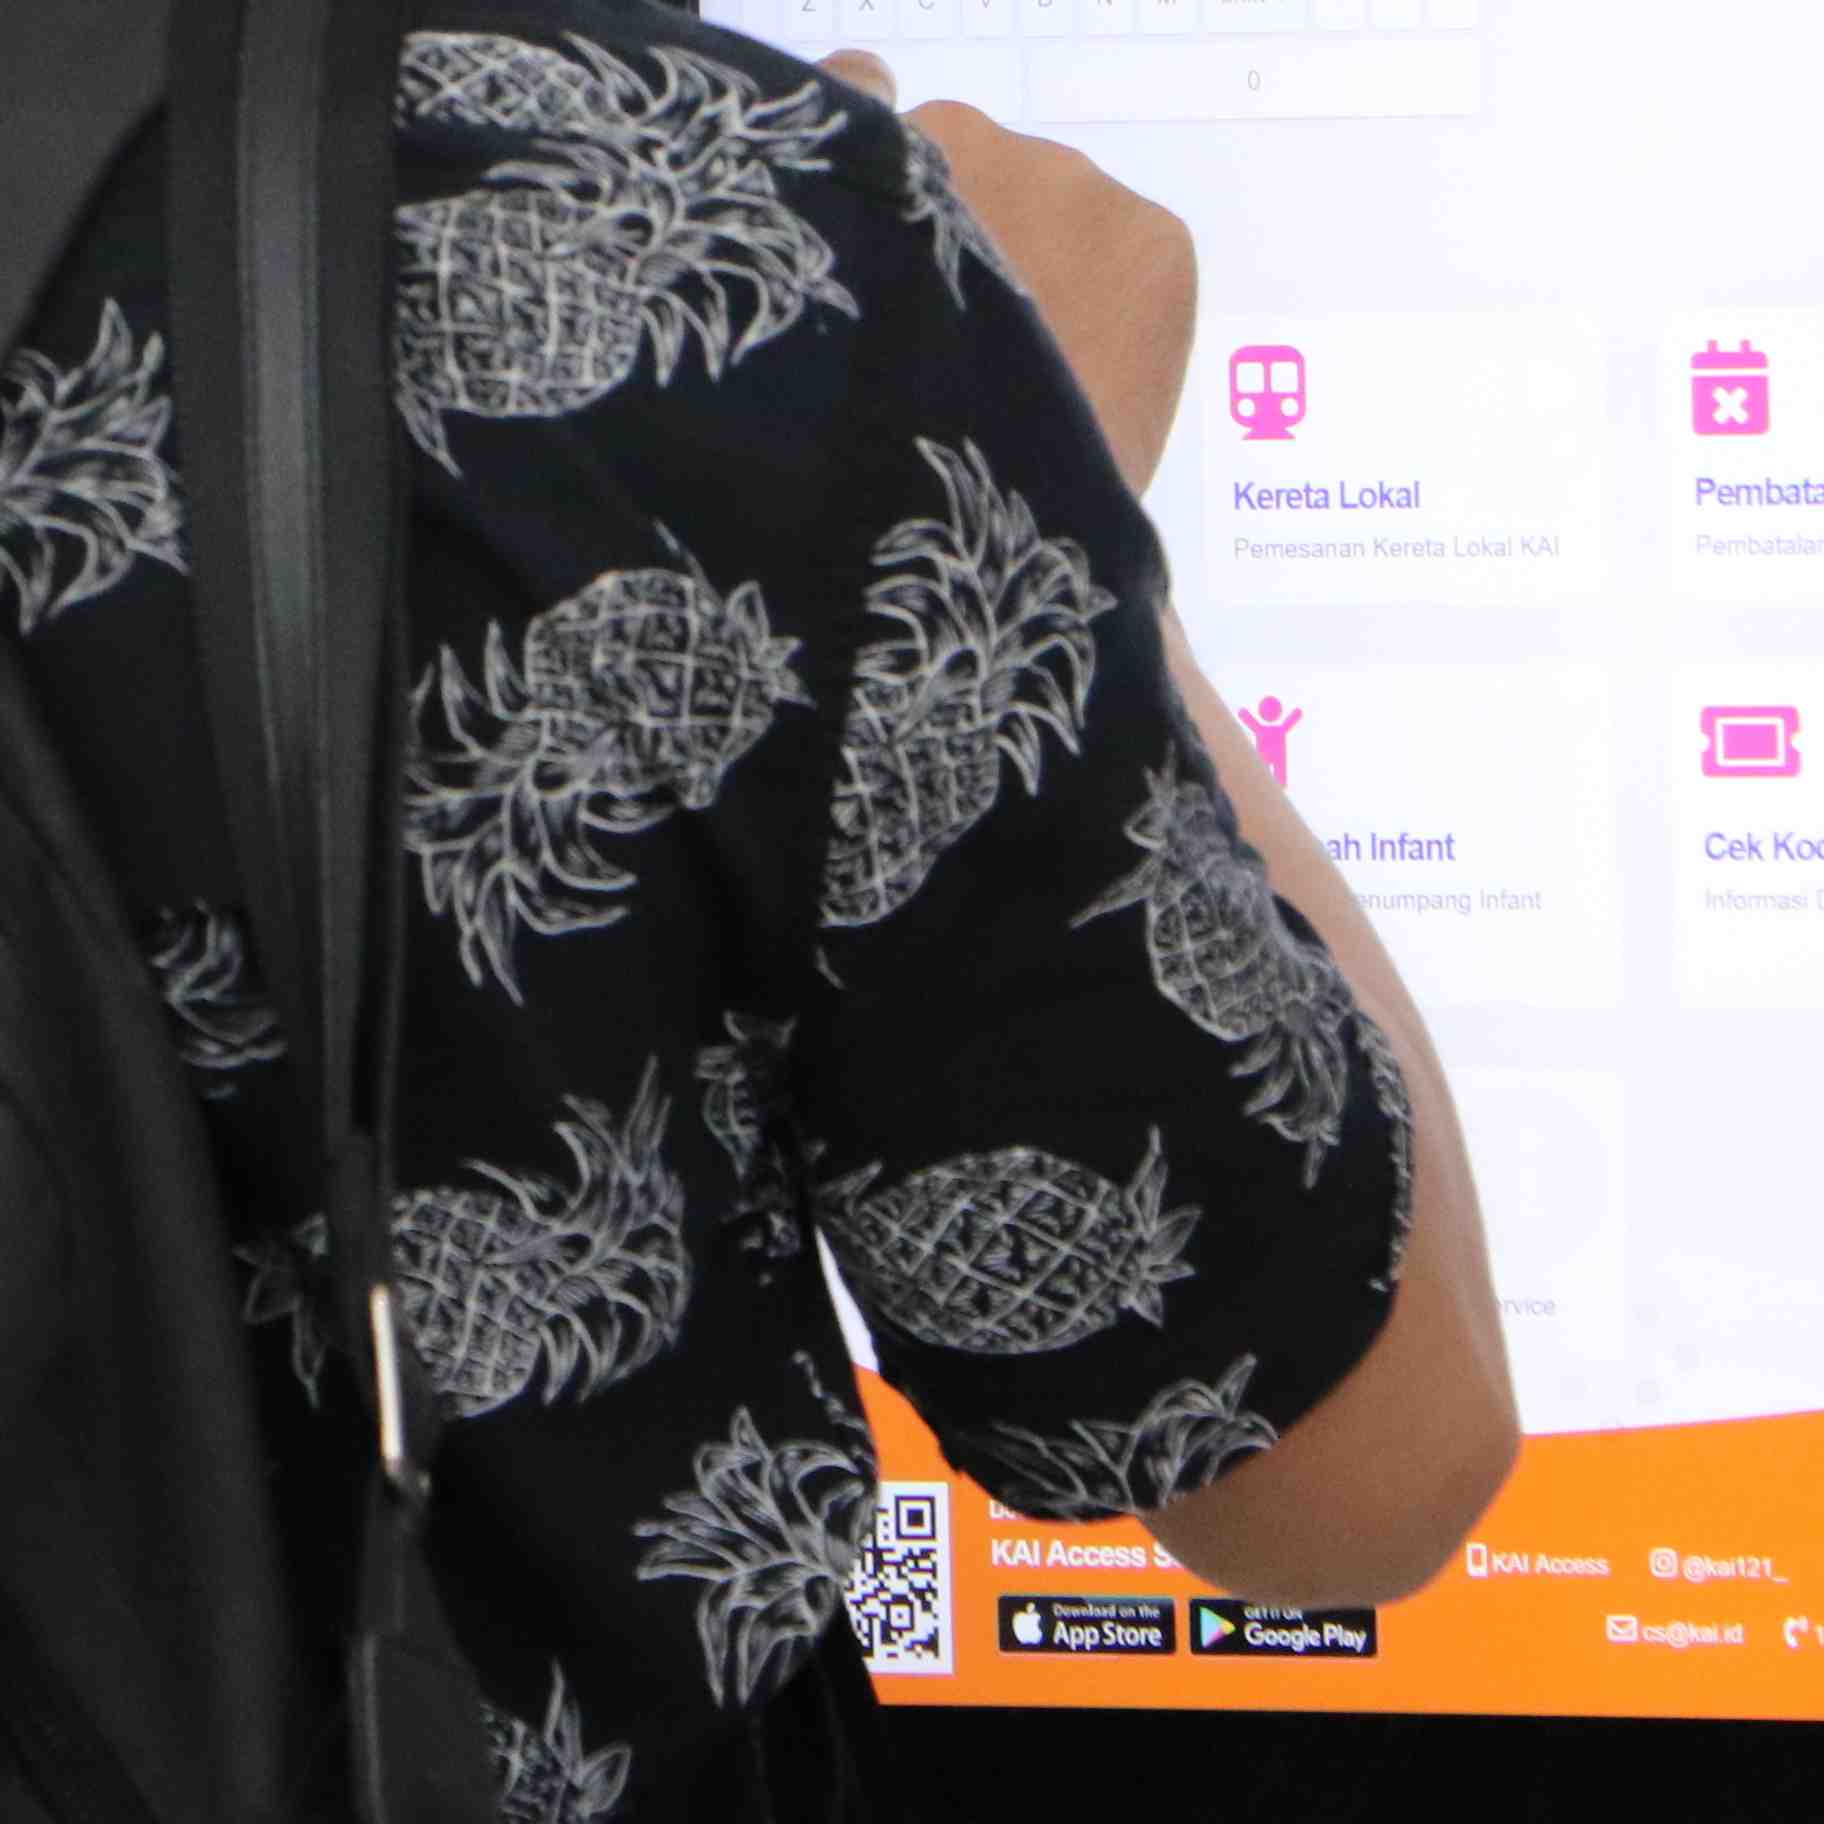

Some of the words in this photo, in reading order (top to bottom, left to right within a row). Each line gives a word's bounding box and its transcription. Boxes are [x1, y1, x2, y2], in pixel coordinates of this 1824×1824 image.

[1247, 70, 1259, 90] 0
[1234, 480, 1330, 510] Kereta
[1339, 479, 1419, 509] Lokal
[1234, 536, 1365, 558] Pemesanan
[1373, 537, 1444, 557] Kereta
[1452, 536, 1513, 557] Lokal
[1519, 537, 1558, 556] KAI
[1370, 832, 1455, 861] Infant
[1705, 833, 1763, 861] Cek
[1352, 889, 1473, 912] enumpang
[1481, 888, 1541, 910] Infant
[1705, 889, 1808, 910] Informasi
[1498, 1299, 1555, 1314] rvice
[992, 1539, 1041, 1565] KAI
[1047, 1540, 1146, 1568] Access
[1492, 1553, 1529, 1574] KAI
[1536, 1554, 1609, 1575] Access
[1683, 1556, 1789, 1583] @kai121_
[1053, 1605, 1118, 1619] Download
[1120, 1607, 1135, 1617] on
[1139, 1605, 1160, 1618] the
[1054, 1622, 1101, 1651] App
[1102, 1622, 1162, 1647] Store
[1245, 1623, 1320, 1651] Google
[1324, 1623, 1367, 1653] Play
[1643, 1623, 1743, 1646] cs@kai.id
